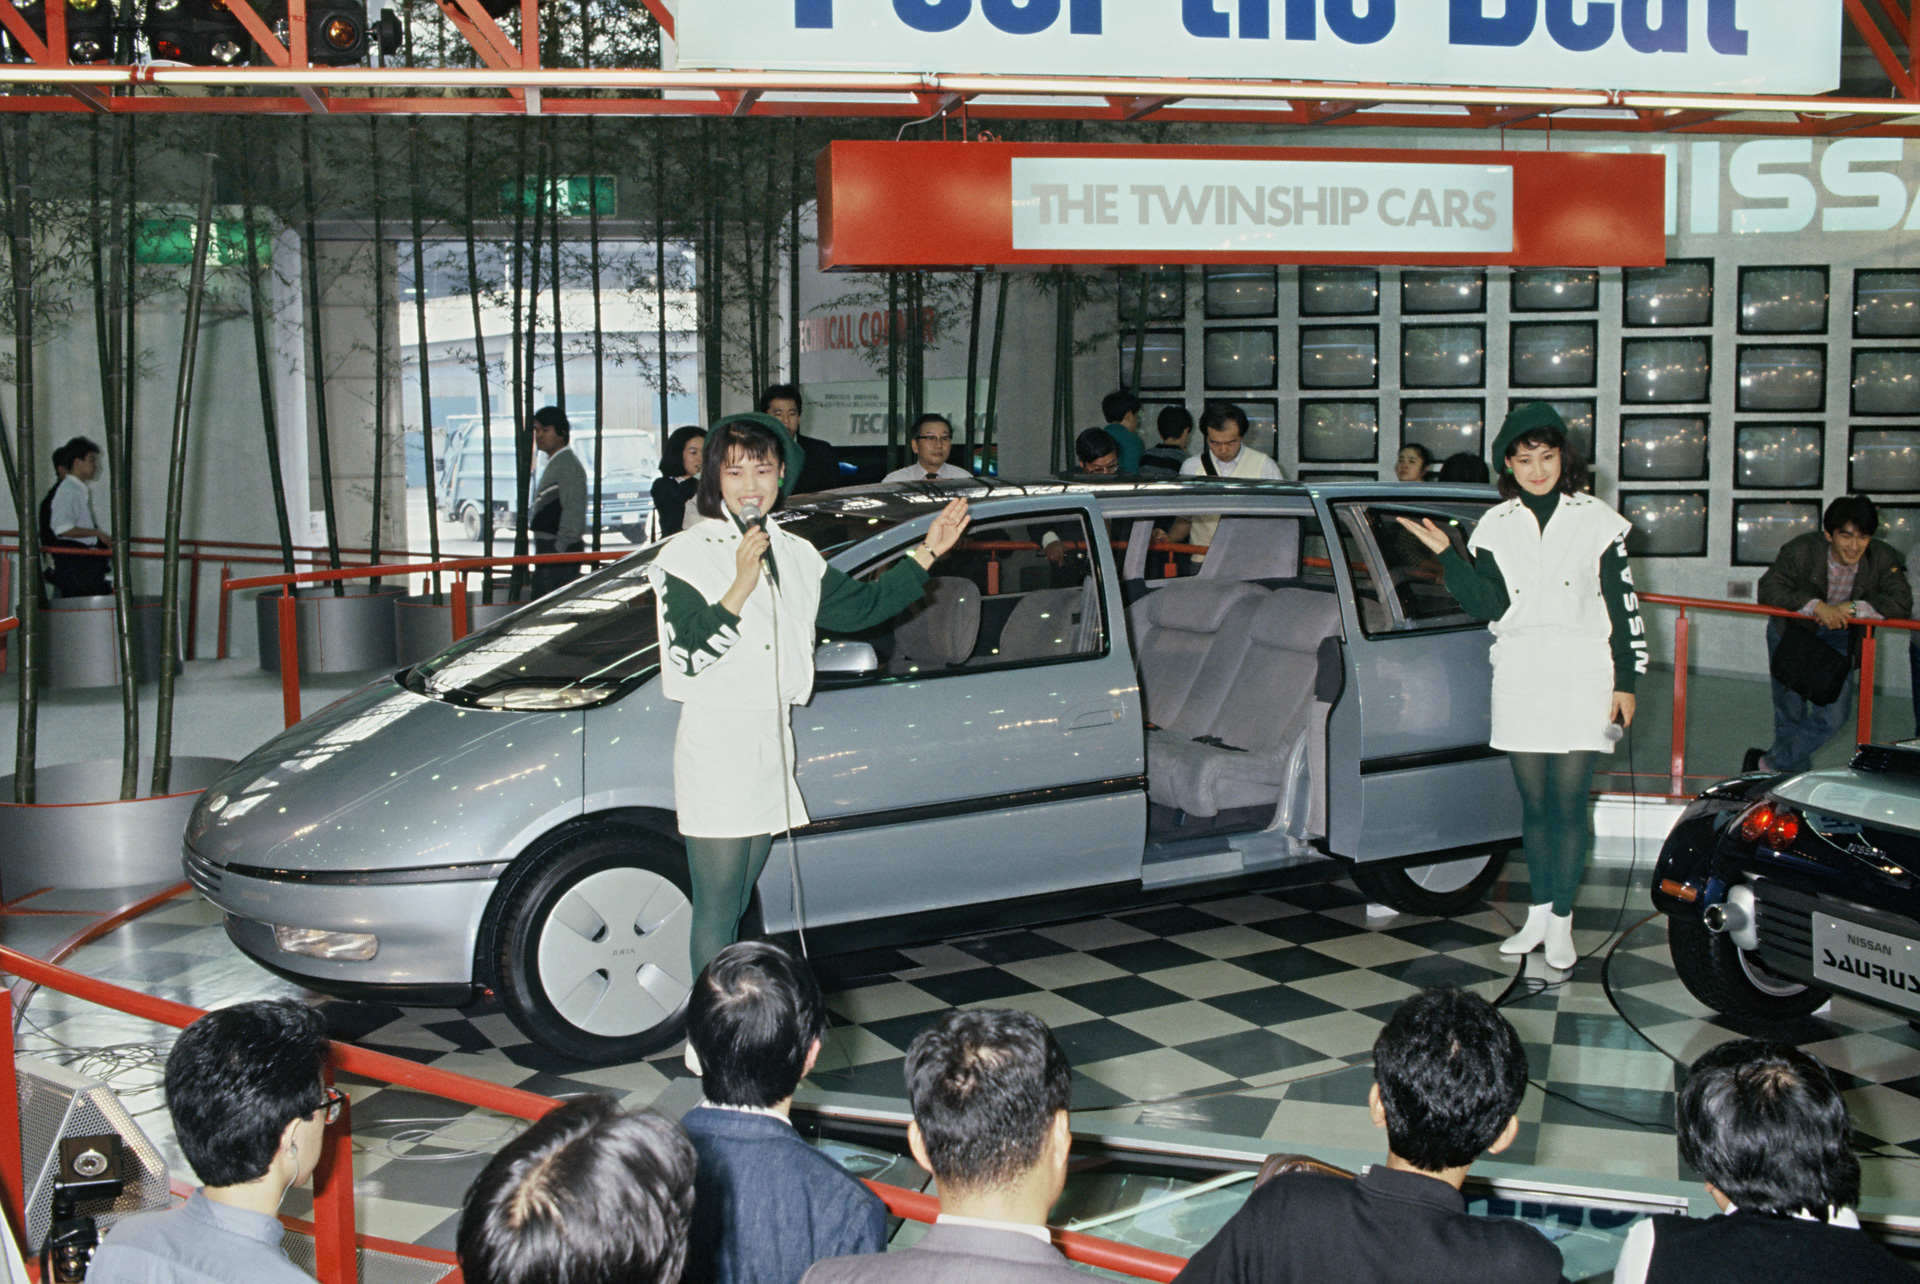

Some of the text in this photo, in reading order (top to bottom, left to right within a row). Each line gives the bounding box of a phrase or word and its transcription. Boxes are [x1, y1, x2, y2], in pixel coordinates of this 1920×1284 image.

[1031, 184, 1497, 230] THE TWINSHIP CARS
[1585, 136, 1920, 236] ISS
[799, 314, 854, 353] ECHNICAL
[1614, 527, 1650, 675] NISSAN
[1847, 934, 1893, 956] NISSAN
[1822, 948, 1920, 995] SAURUS
